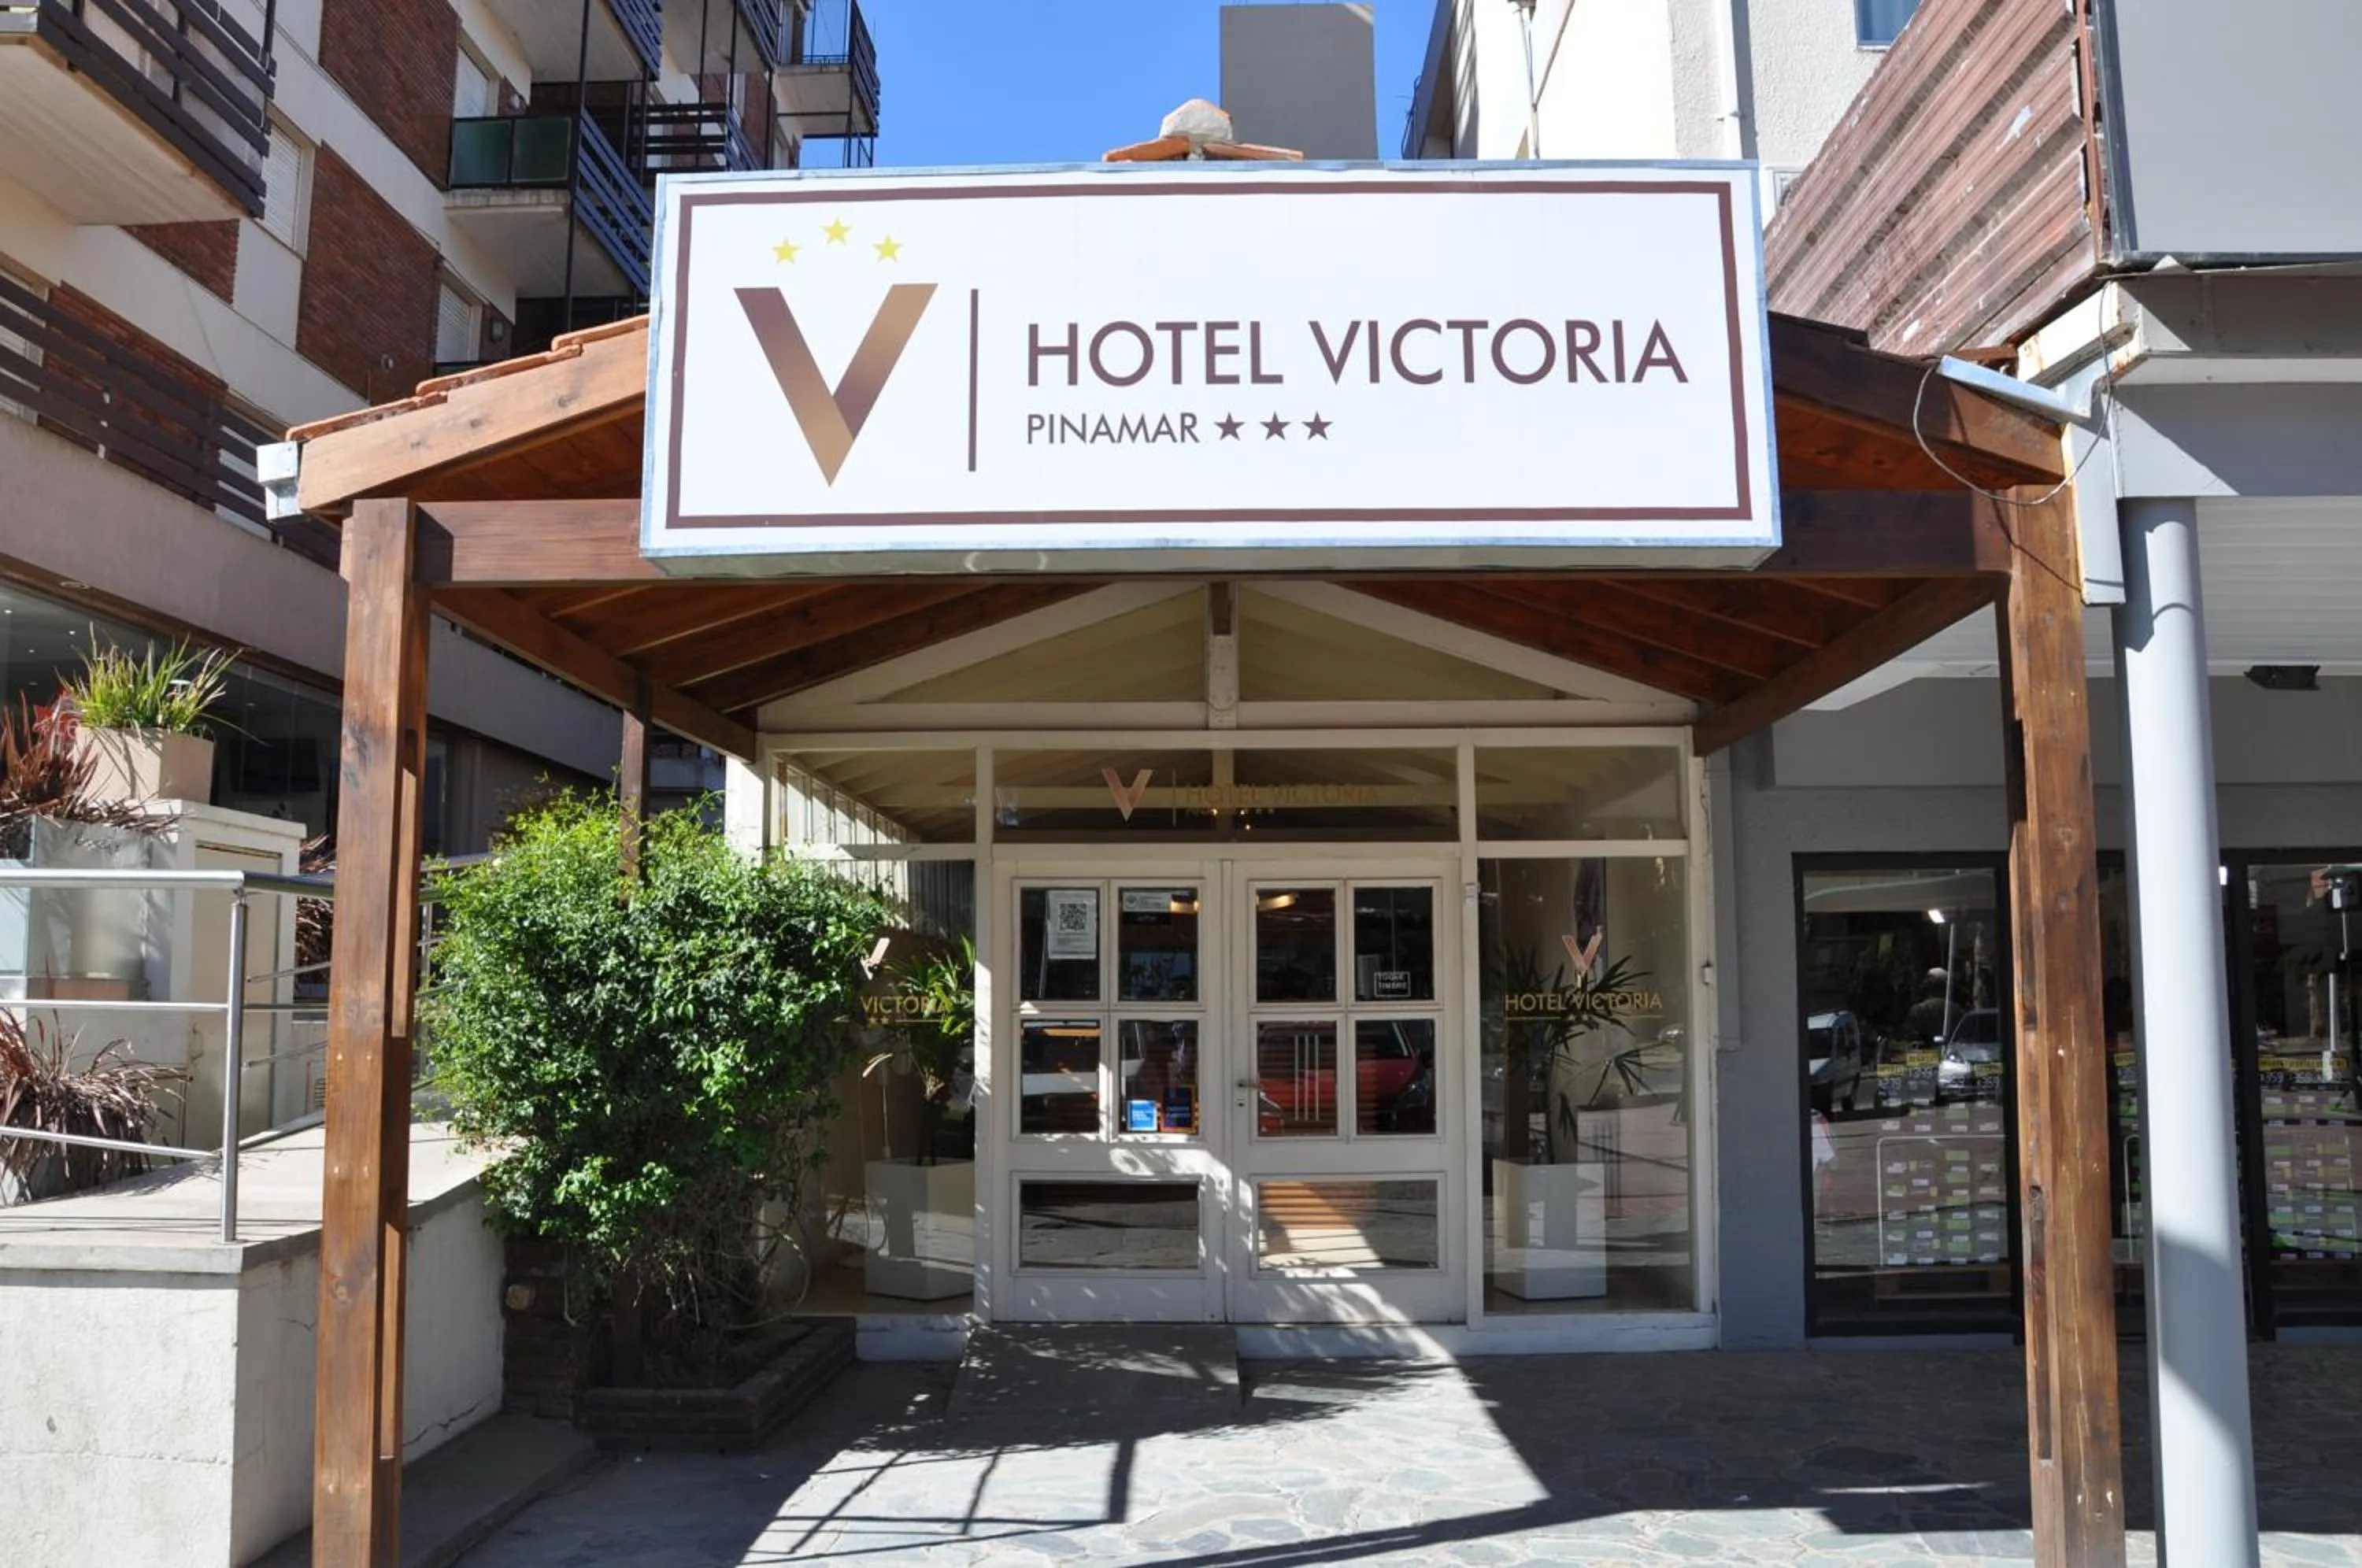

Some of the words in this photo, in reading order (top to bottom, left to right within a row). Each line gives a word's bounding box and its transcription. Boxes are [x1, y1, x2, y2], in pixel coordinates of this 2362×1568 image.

[1027, 320, 1283, 387] HOTEL
[1309, 319, 1689, 385] VICTORIA
[733, 283, 939, 487] V
[1027, 412, 1200, 445] PINAMAR
[1272, 782, 1379, 804] VICTORIA
[860, 995, 951, 1014] VICTORA
[1505, 993, 1567, 1011] HOTEL
[1572, 992, 1663, 1011] VICTORIA
